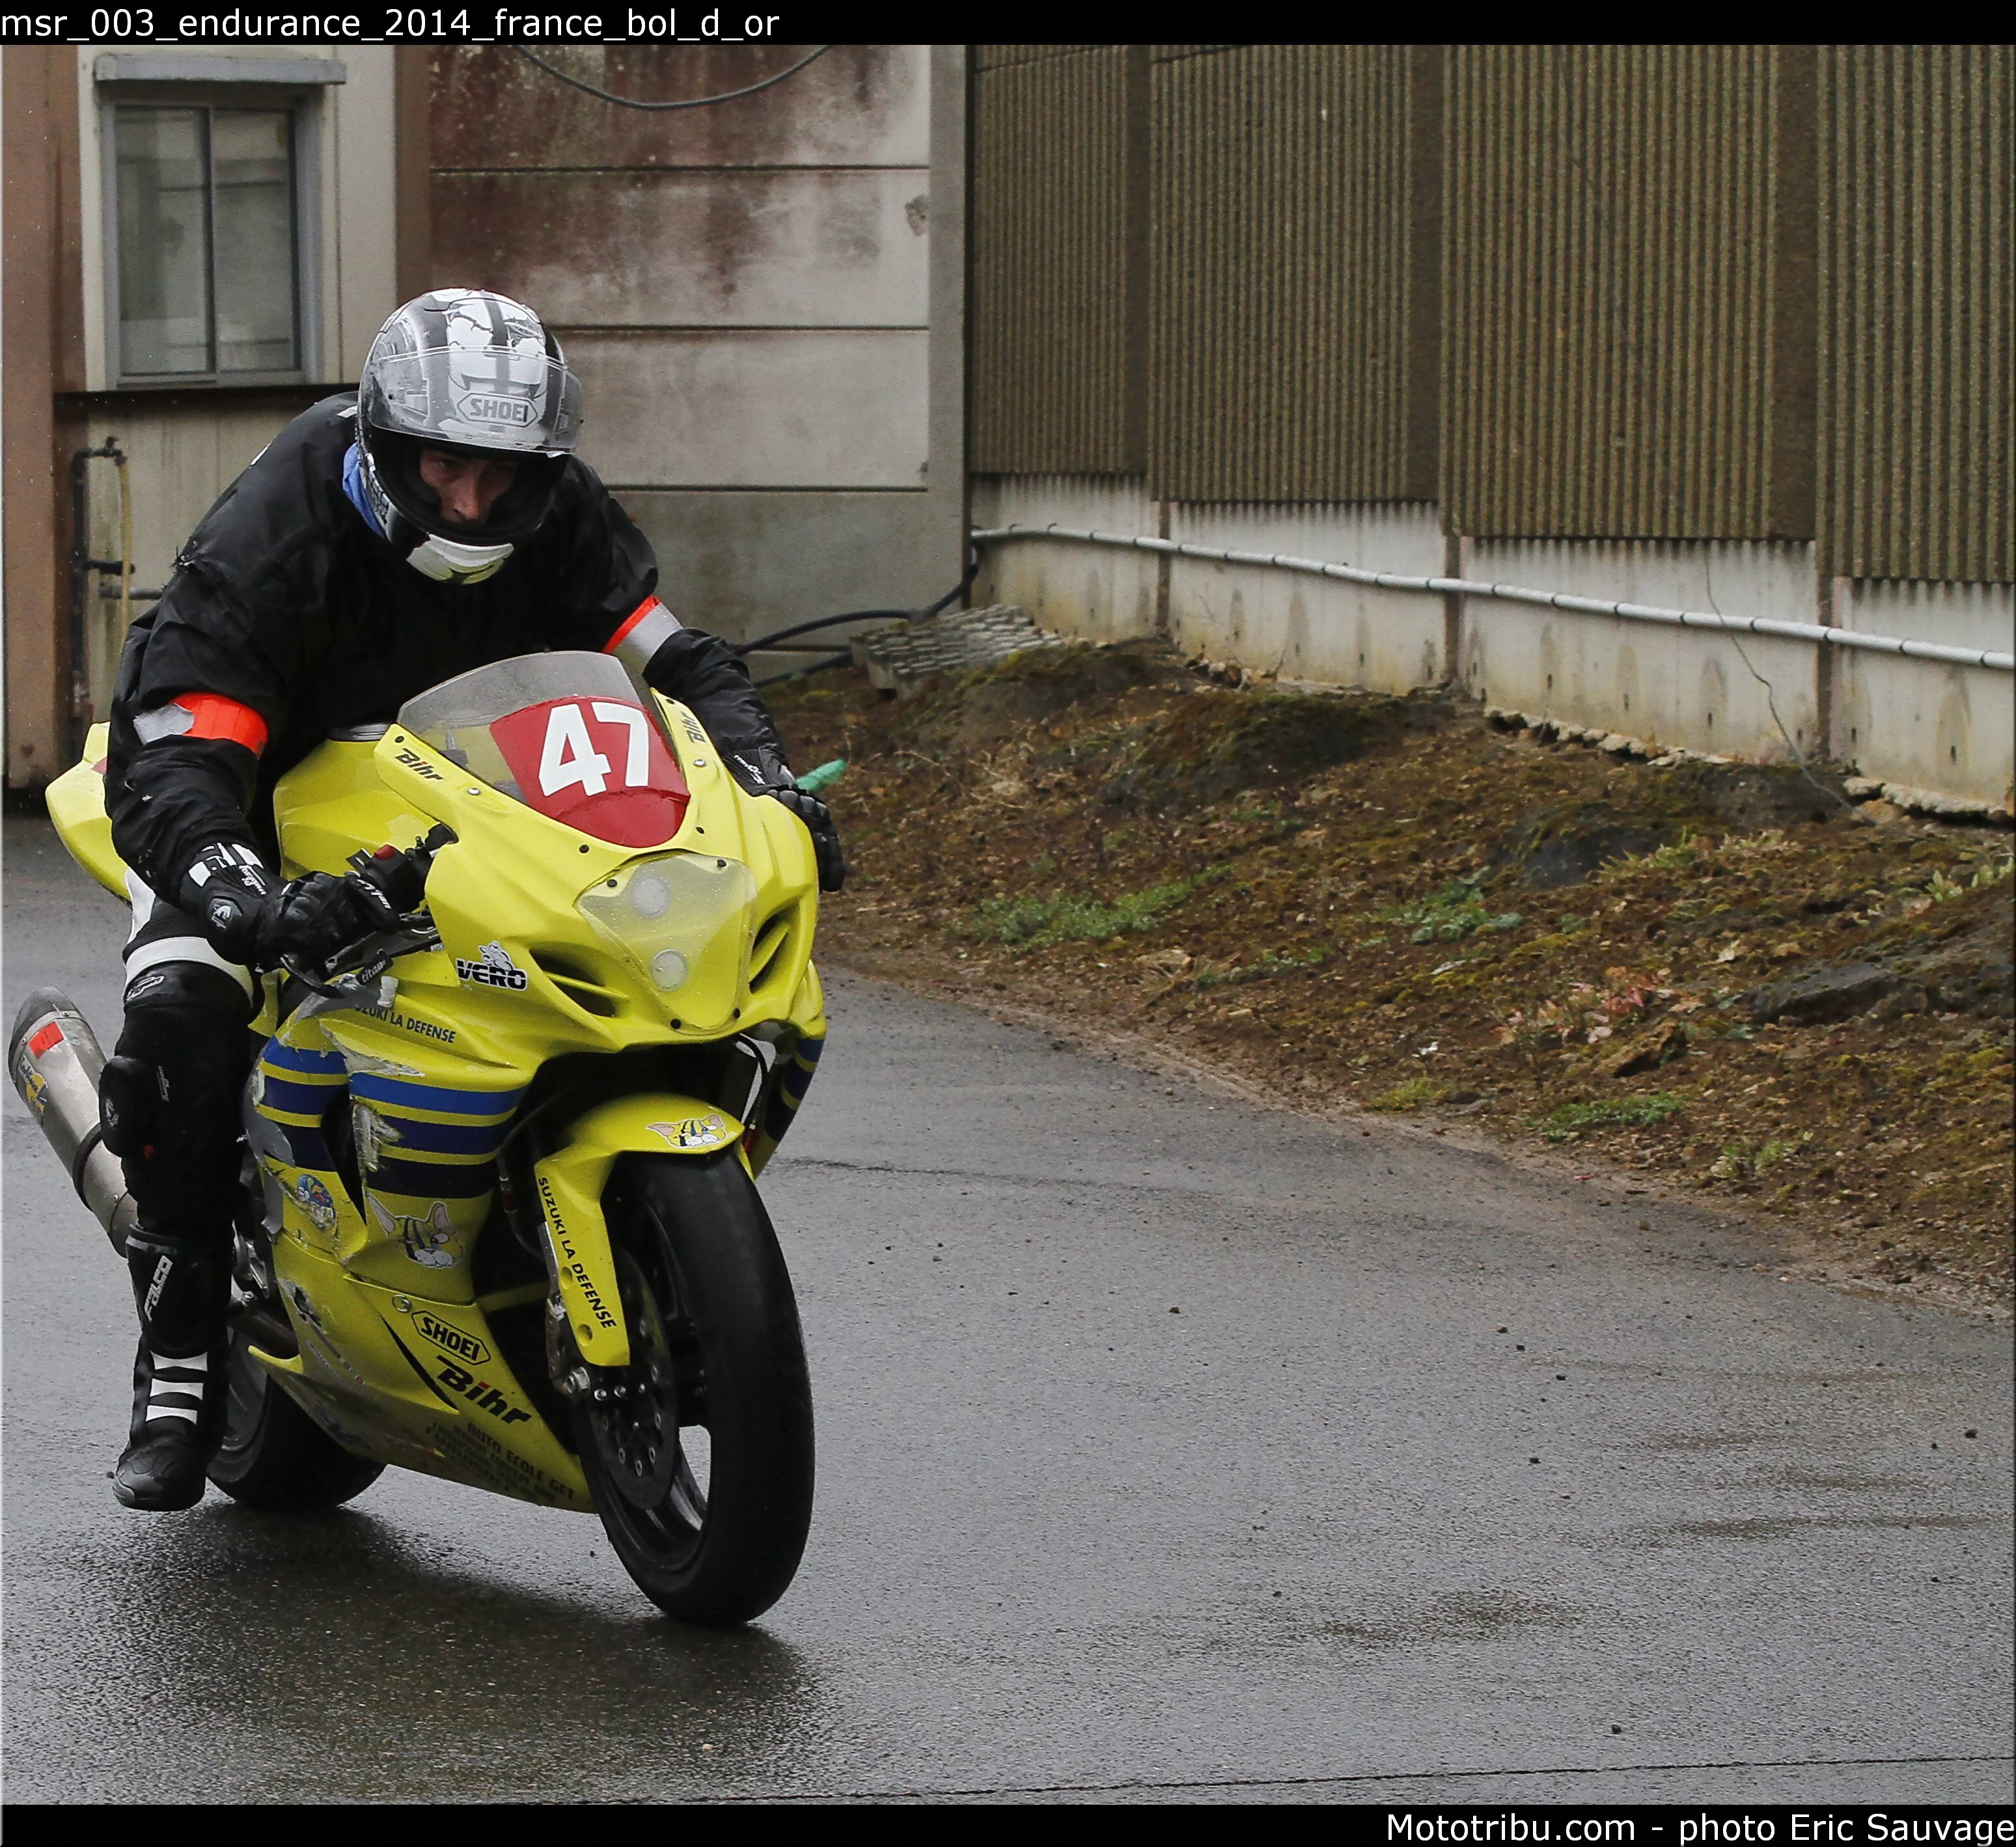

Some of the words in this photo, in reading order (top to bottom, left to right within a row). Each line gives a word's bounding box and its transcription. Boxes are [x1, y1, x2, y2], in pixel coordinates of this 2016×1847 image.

[469, 397, 529, 422] SHOEI
[687, 709, 706, 744] Bihr
[394, 747, 444, 781] Bihr
[538, 701, 649, 797] 47
[457, 959, 527, 990] VERO
[391, 1011, 403, 1027] LA
[407, 1017, 456, 1044] DEFENSE
[538, 1176, 568, 1235] SUZUKI
[560, 1238, 575, 1259] LA
[571, 1262, 617, 1329] DEFENSE
[421, 1315, 482, 1361] SHOEI
[435, 1355, 533, 1425] Bihr
[467, 1422, 501, 1453] AUTO
[506, 1450, 545, 1481] ECOLE
